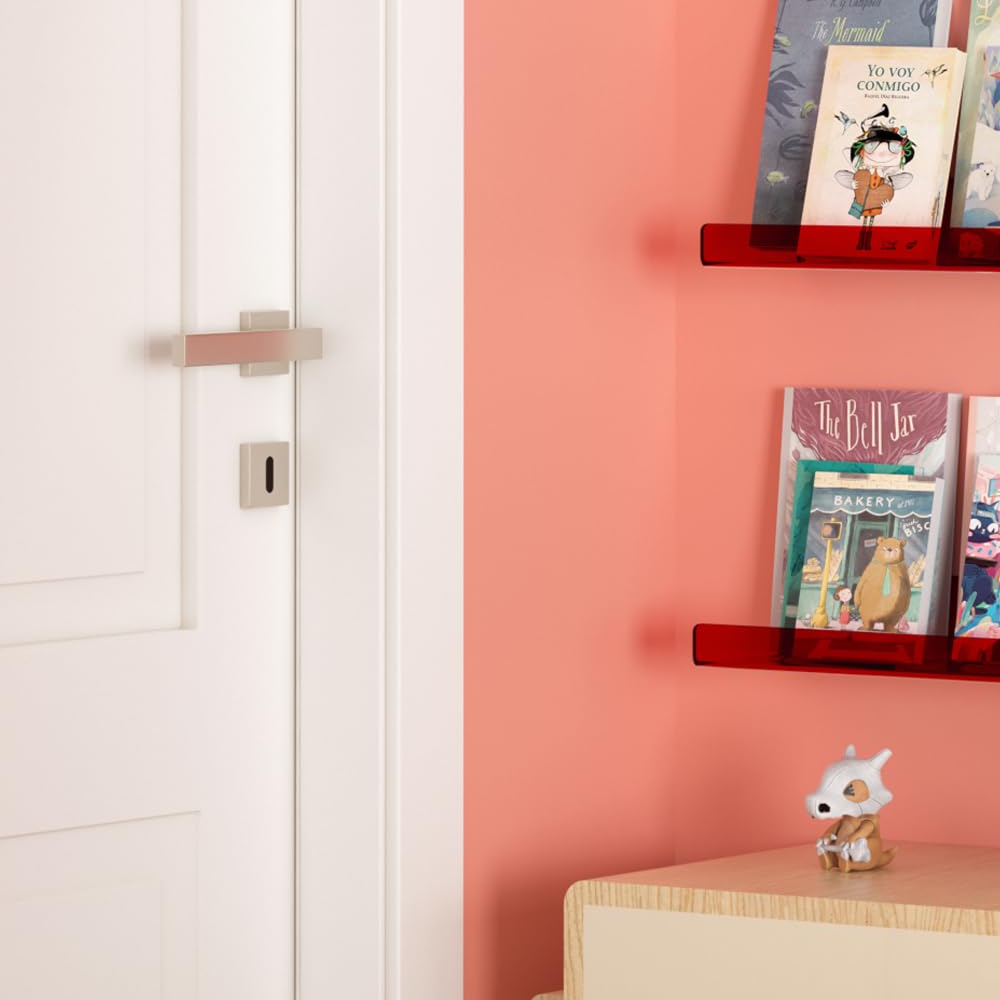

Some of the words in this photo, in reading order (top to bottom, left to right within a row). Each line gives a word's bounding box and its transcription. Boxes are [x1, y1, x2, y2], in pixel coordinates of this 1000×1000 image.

[811, 20, 828, 41] The
[825, 17, 890, 45] Mermaid
[888, 67, 915, 78] VOY
[857, 80, 920, 92] CONMIGO
[814, 400, 840, 439] The
[847, 399, 883, 455] Bell
[890, 401, 917, 441] Jar
[834, 495, 895, 508] BAKERY
